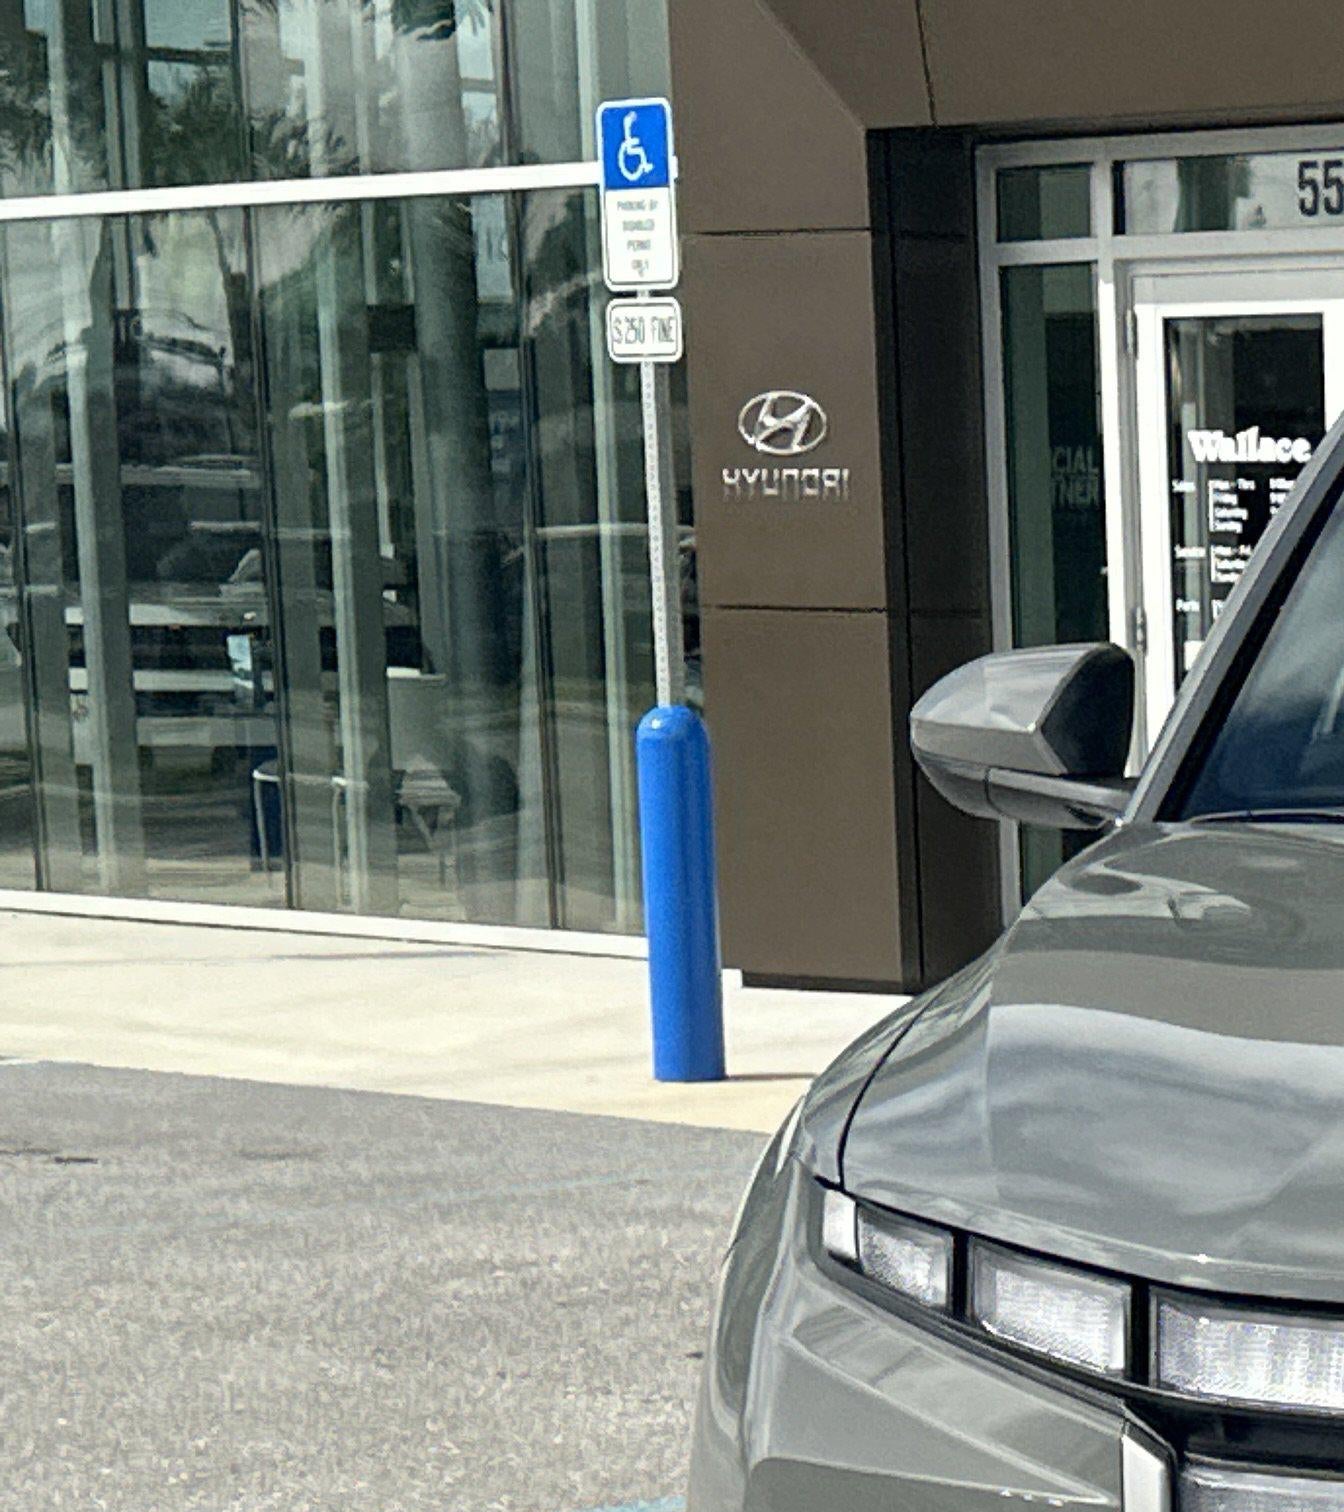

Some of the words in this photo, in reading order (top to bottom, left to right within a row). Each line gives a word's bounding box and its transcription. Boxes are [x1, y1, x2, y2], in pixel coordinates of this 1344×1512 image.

[651, 316, 675, 343] FINE
[1187, 425, 1312, 463] Wallace
[722, 468, 849, 499] HYUNDAI
